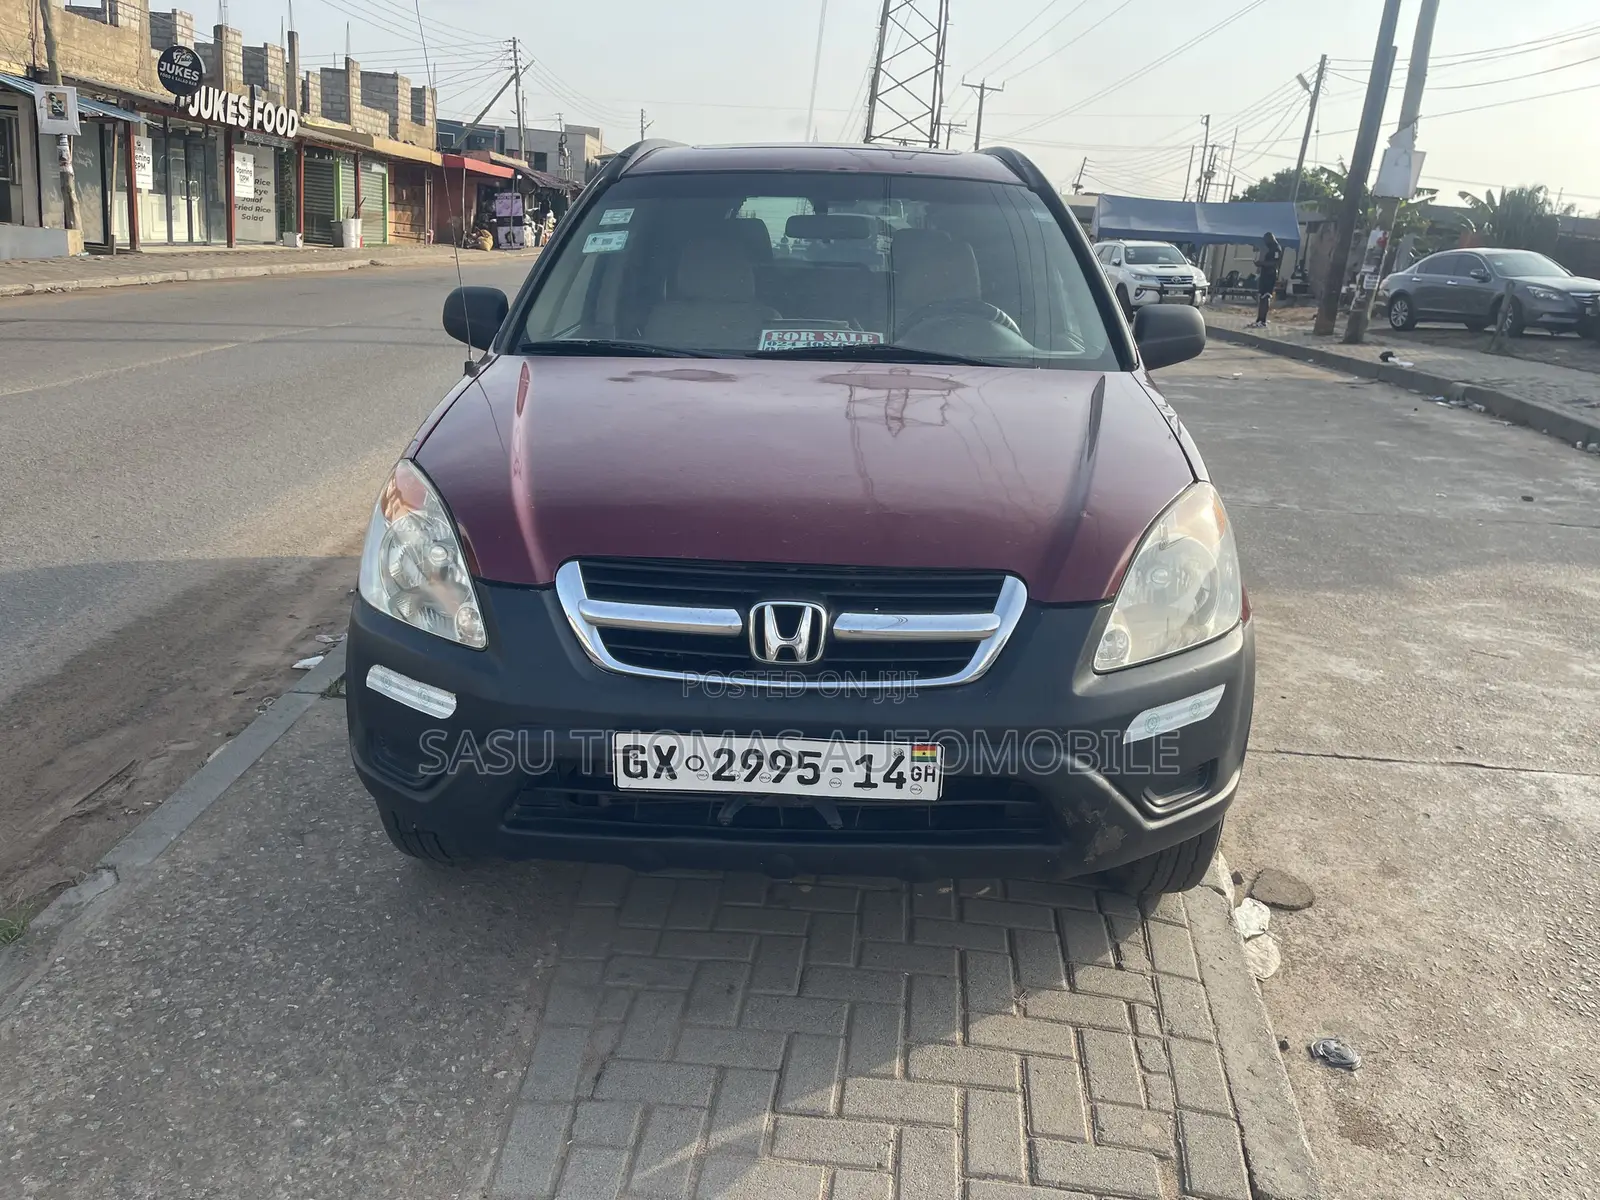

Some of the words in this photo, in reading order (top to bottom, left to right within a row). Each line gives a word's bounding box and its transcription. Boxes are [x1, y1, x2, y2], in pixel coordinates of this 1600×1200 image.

[160, 61, 200, 81] JUKES
[188, 85, 250, 127] JUKES
[253, 99, 298, 138] FOOD
[135, 153, 150, 164] ening
[236, 166, 252, 177] Opening
[254, 178, 271, 186] Rice
[254, 187, 268, 196] kye
[235, 204, 253, 212] Fried
[255, 206, 271, 214] Rice
[241, 213, 264, 222] Salad
[771, 331, 816, 341] FOR
[823, 331, 874, 343] SALE
[622, 744, 678, 780] GX
[910, 765, 937, 783] GH
